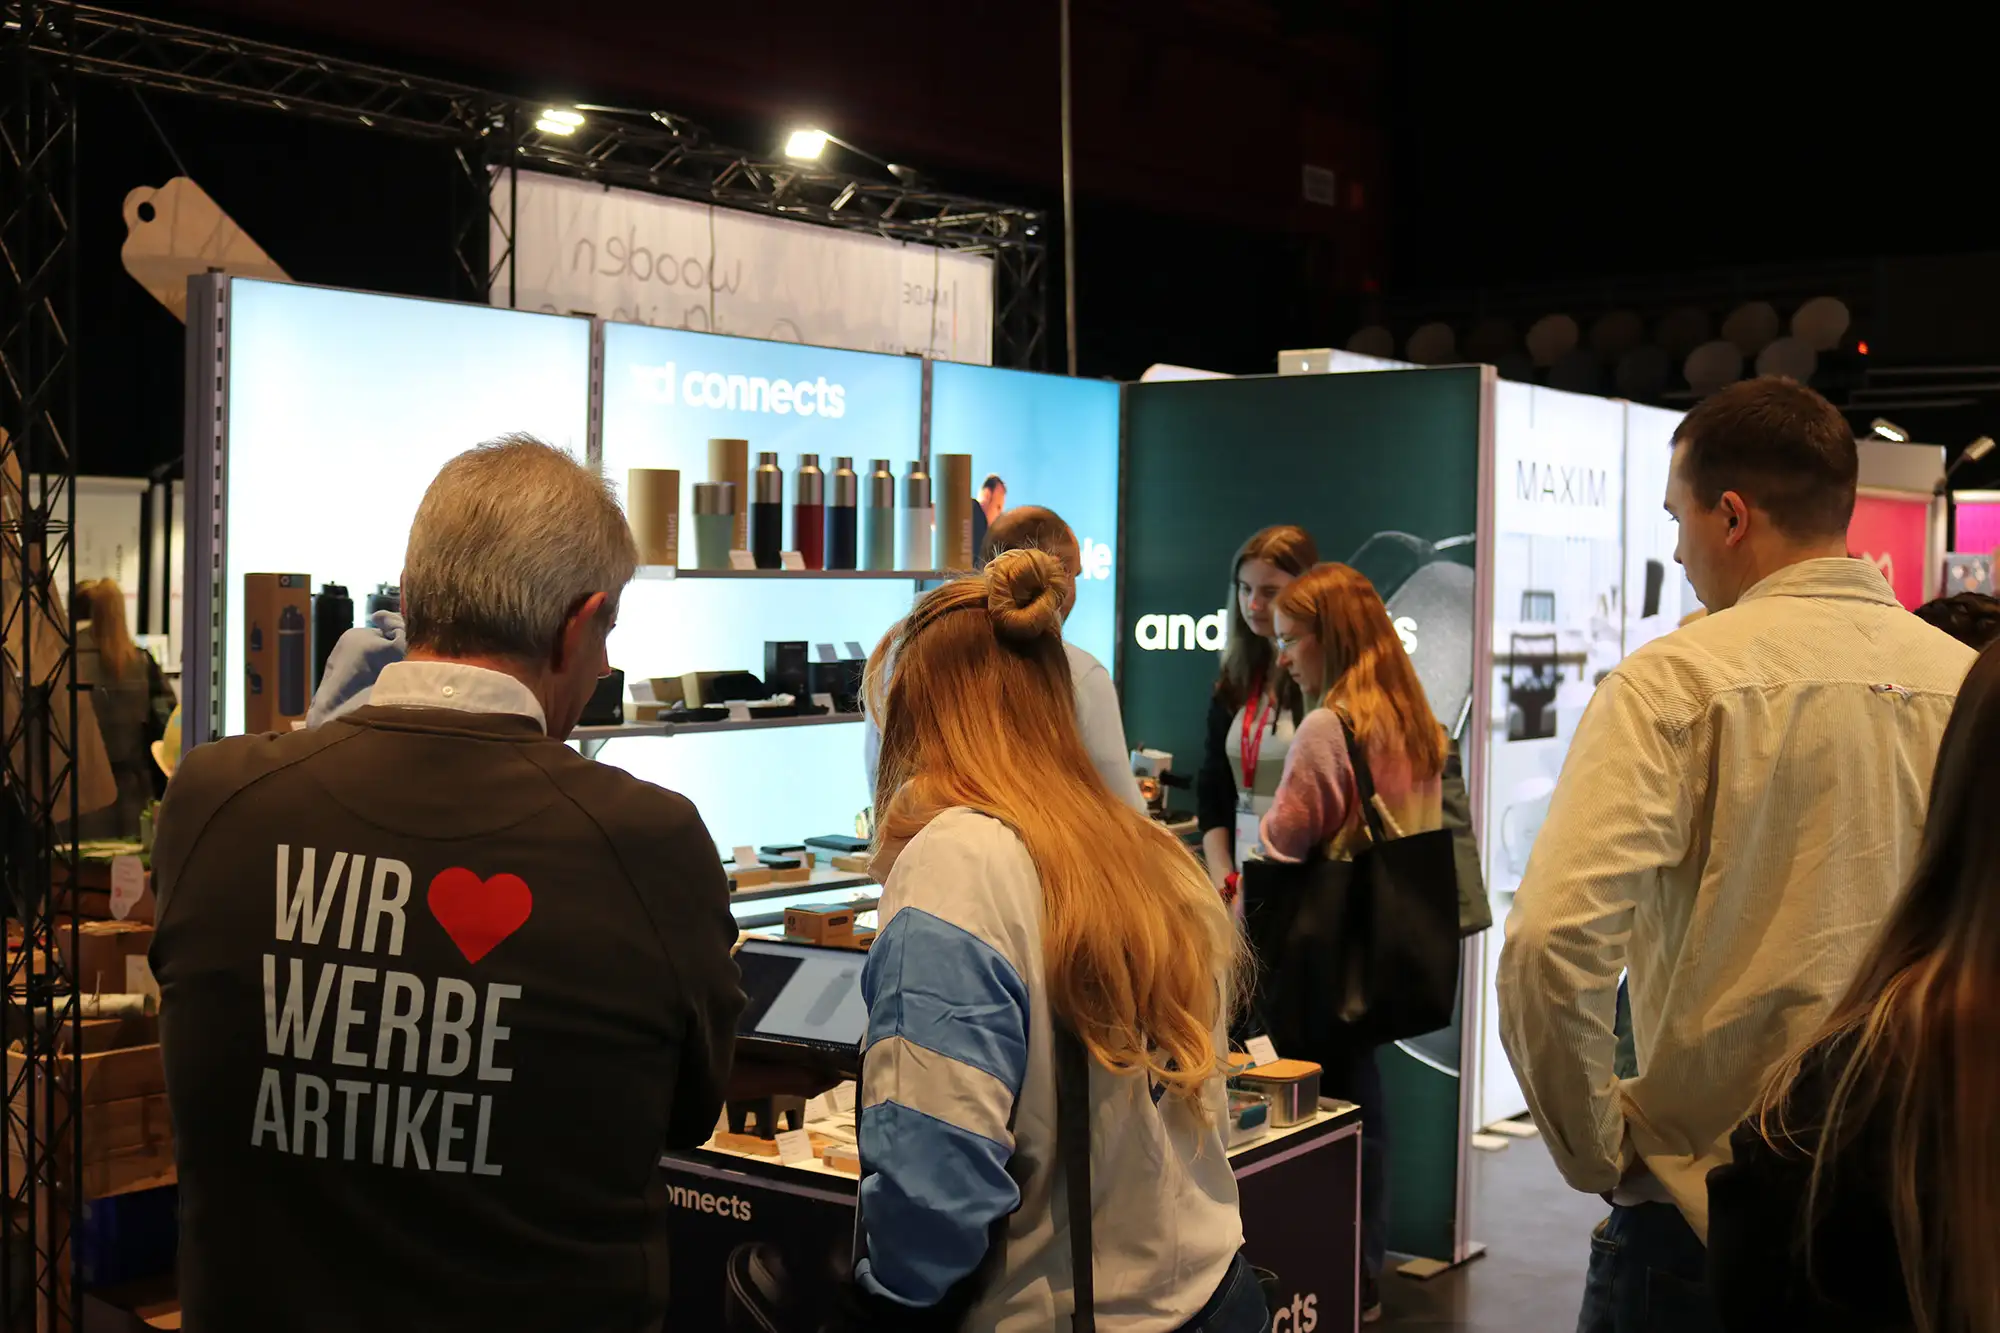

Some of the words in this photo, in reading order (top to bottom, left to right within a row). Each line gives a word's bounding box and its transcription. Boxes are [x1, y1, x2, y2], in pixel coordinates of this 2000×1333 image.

[683, 371, 845, 418] connects
[1516, 460, 1605, 507] MAXIM
[1080, 538, 1112, 580] le
[1135, 609, 1228, 651] and
[275, 844, 412, 956] WIR
[263, 953, 522, 1082] WERBE
[251, 1067, 503, 1176] ARTIKEL
[666, 1183, 752, 1222] nnects
